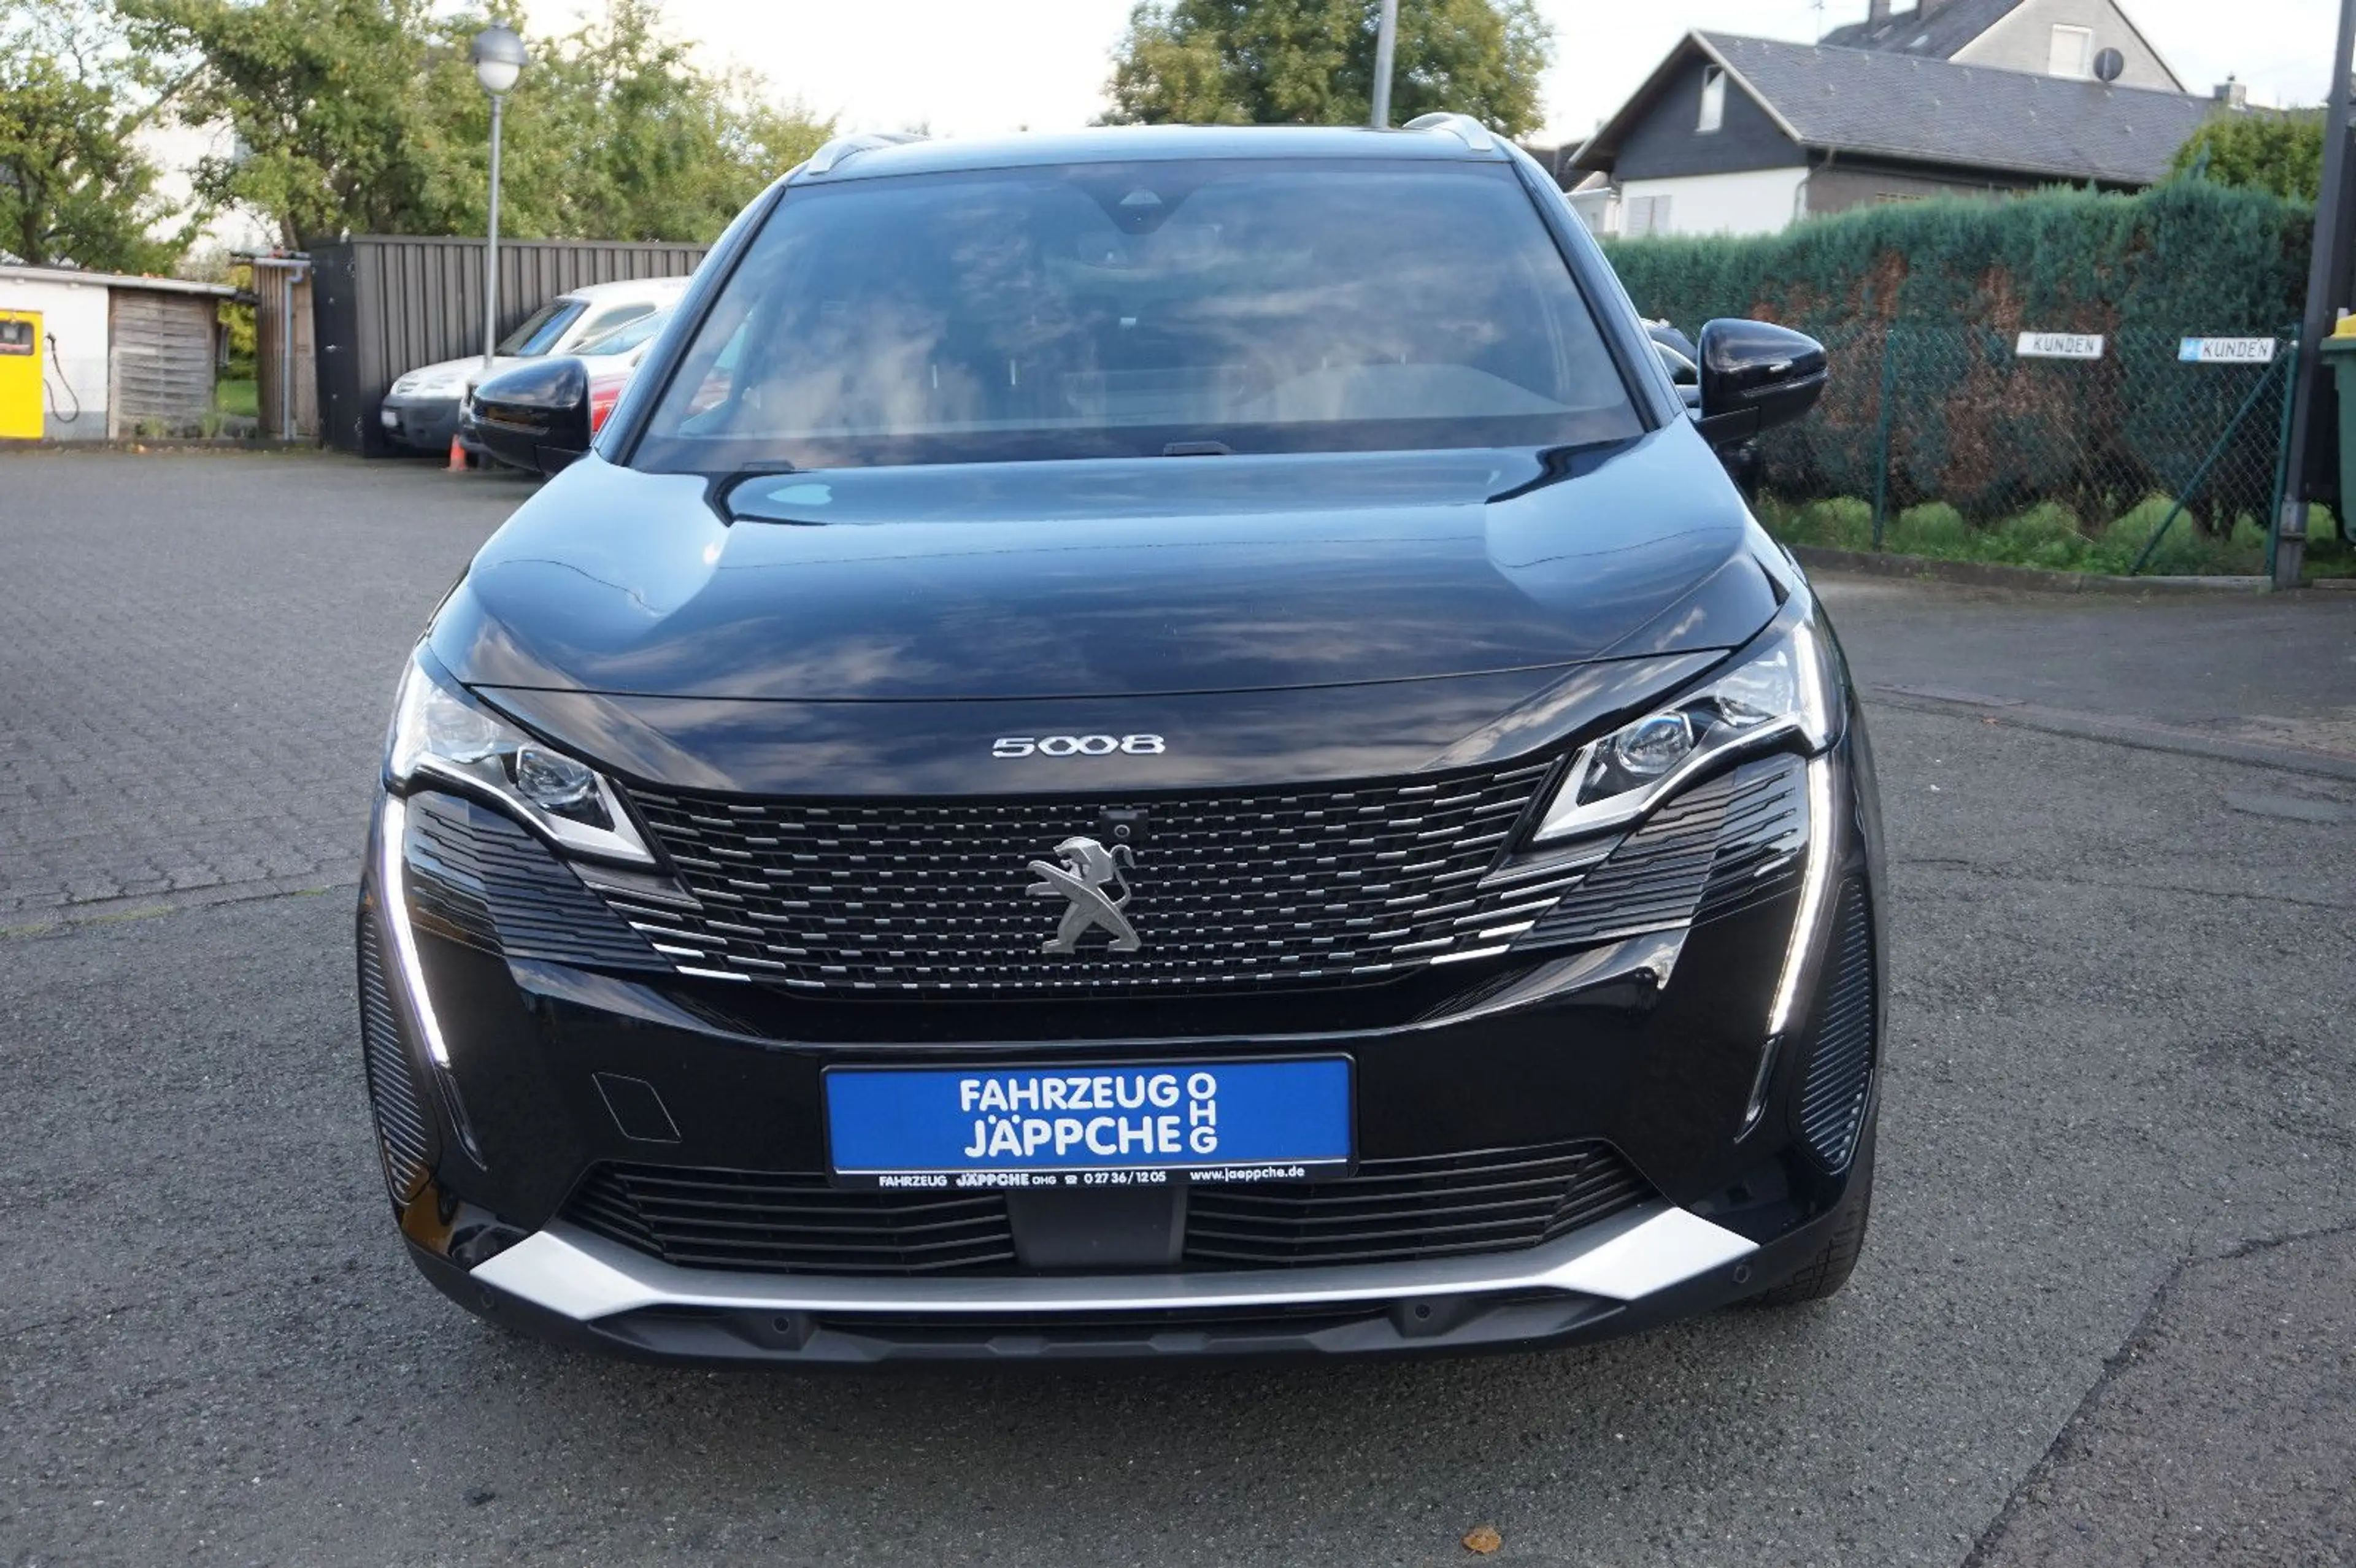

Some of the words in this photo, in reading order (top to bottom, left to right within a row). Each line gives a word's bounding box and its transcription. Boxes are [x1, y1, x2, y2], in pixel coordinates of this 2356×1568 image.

[2033, 337, 2094, 353] KUNDEN
[2203, 340, 2269, 358] KUNDEN
[992, 734, 1165, 758] 5008
[960, 1074, 1180, 1111] FAHRZEUG
[1187, 1072, 1218, 1154] OHG
[964, 1114, 1182, 1157] JÄPPCHE
[879, 1175, 947, 1186] FAHRZEUG
[955, 1173, 1030, 1187] JÄPPCHE
[1032, 1175, 1057, 1185] OHG
[1190, 1166, 1305, 1182] www.jaeppche.de
